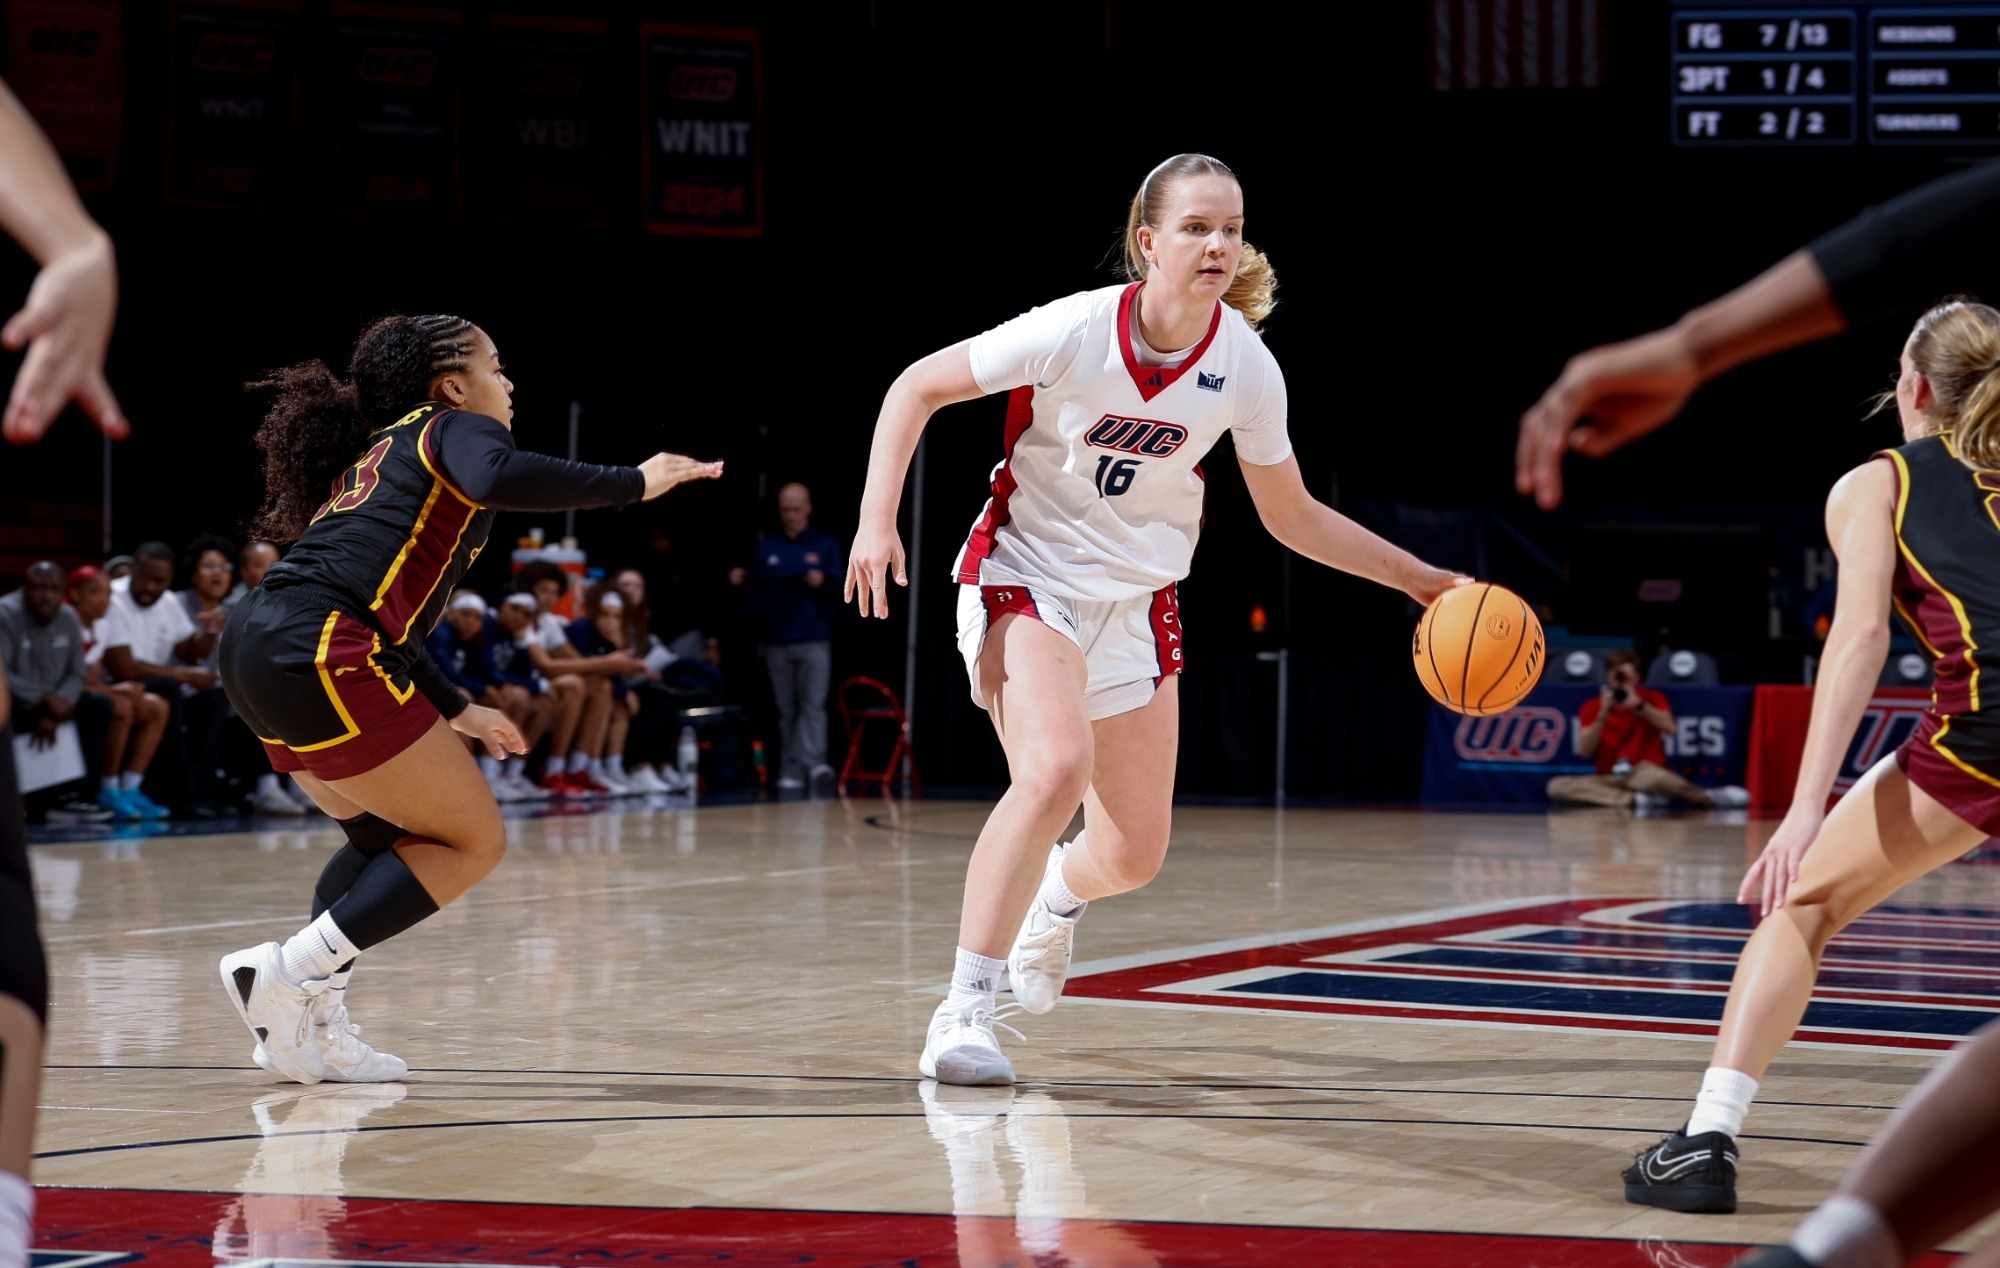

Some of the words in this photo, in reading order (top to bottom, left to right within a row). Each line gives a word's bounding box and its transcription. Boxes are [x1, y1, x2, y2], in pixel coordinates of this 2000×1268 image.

[1688, 22, 1723, 49] FG
[667, 64, 740, 103] UIC
[1678, 66, 1730, 92] 3PT
[656, 116, 752, 157] WNIT
[1688, 111, 1722, 137] FT
[660, 180, 748, 217] 2024
[1084, 413, 1188, 458] UIC
[1095, 454, 1143, 498] 16
[1454, 705, 1566, 763] UIC
